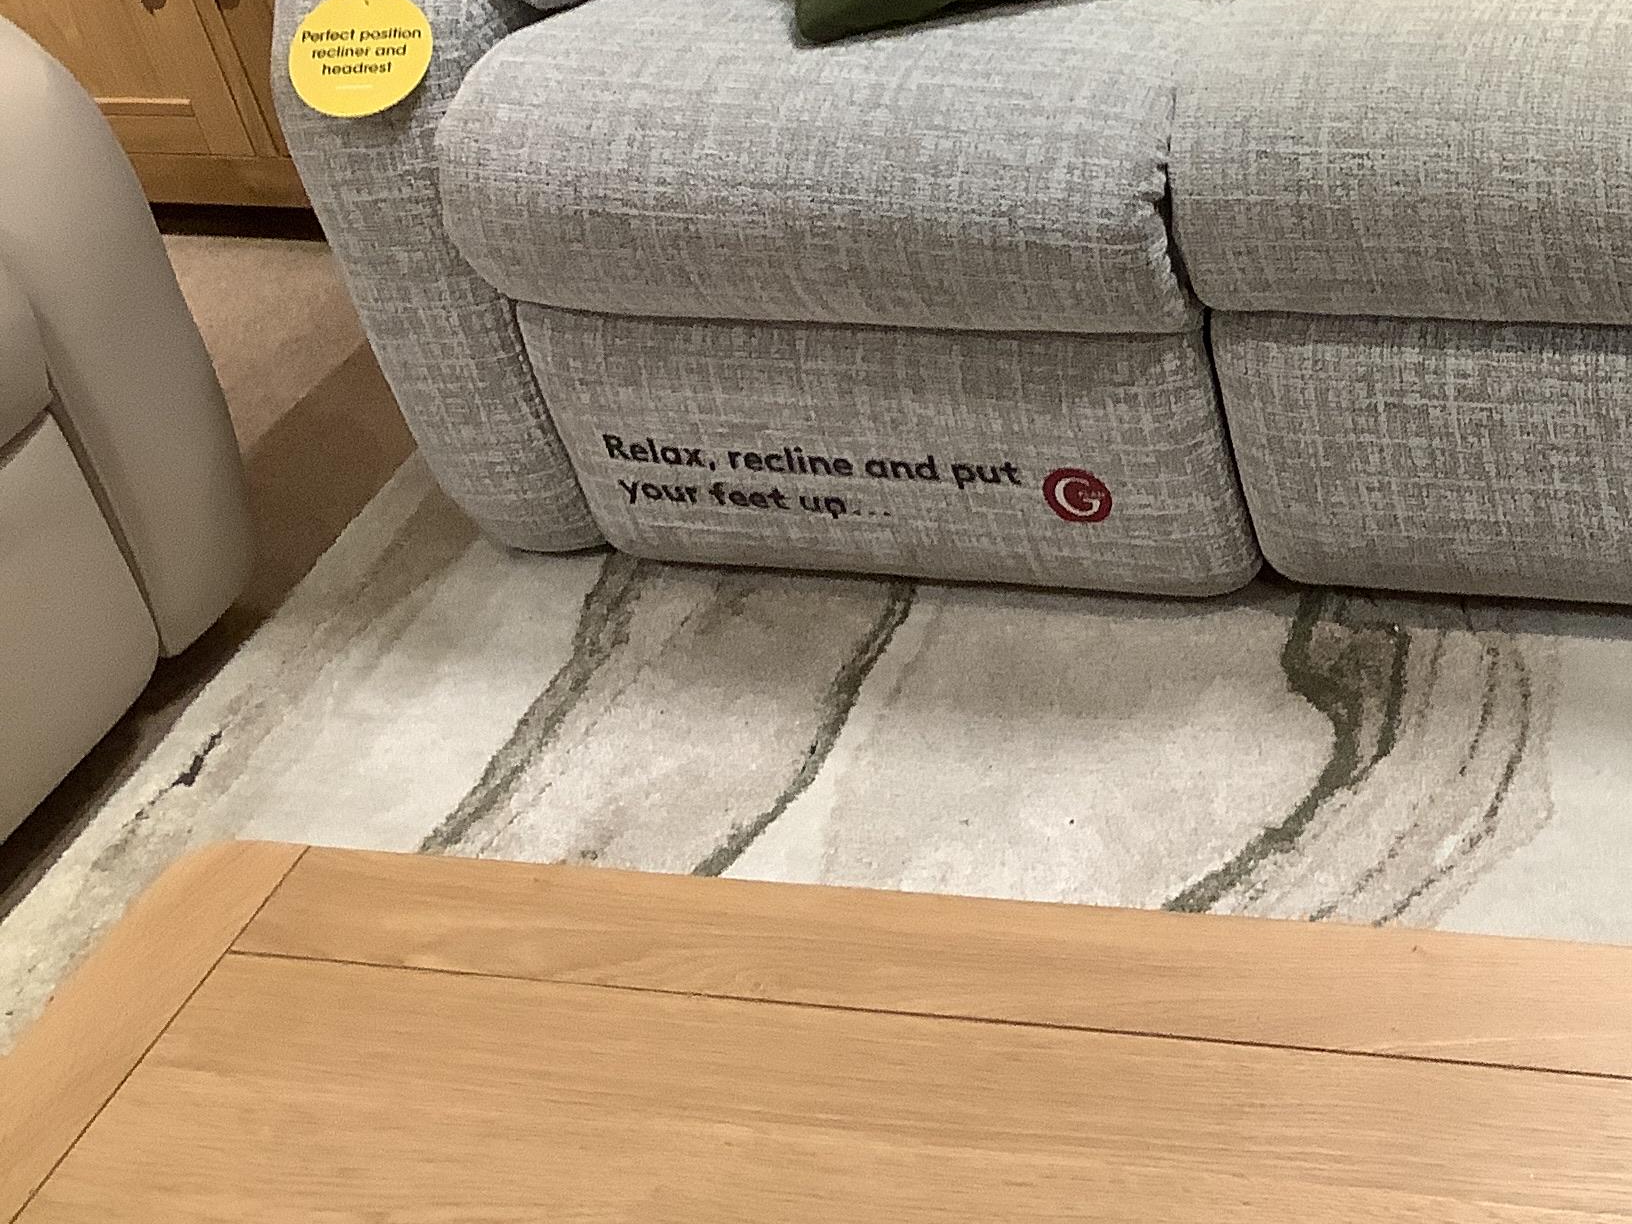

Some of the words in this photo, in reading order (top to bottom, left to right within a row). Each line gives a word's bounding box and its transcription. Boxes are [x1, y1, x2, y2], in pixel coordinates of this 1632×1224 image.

[302, 29, 355, 43] Perfect
[359, 27, 422, 42] position
[312, 45, 370, 59] recliner
[375, 44, 407, 56] and
[322, 61, 392, 76] headrest
[602, 433, 717, 472] Relax,
[727, 446, 855, 477] recline
[865, 455, 941, 481] and
[951, 461, 1022, 490] put
[617, 479, 698, 505] your
[708, 481, 790, 511] feet
